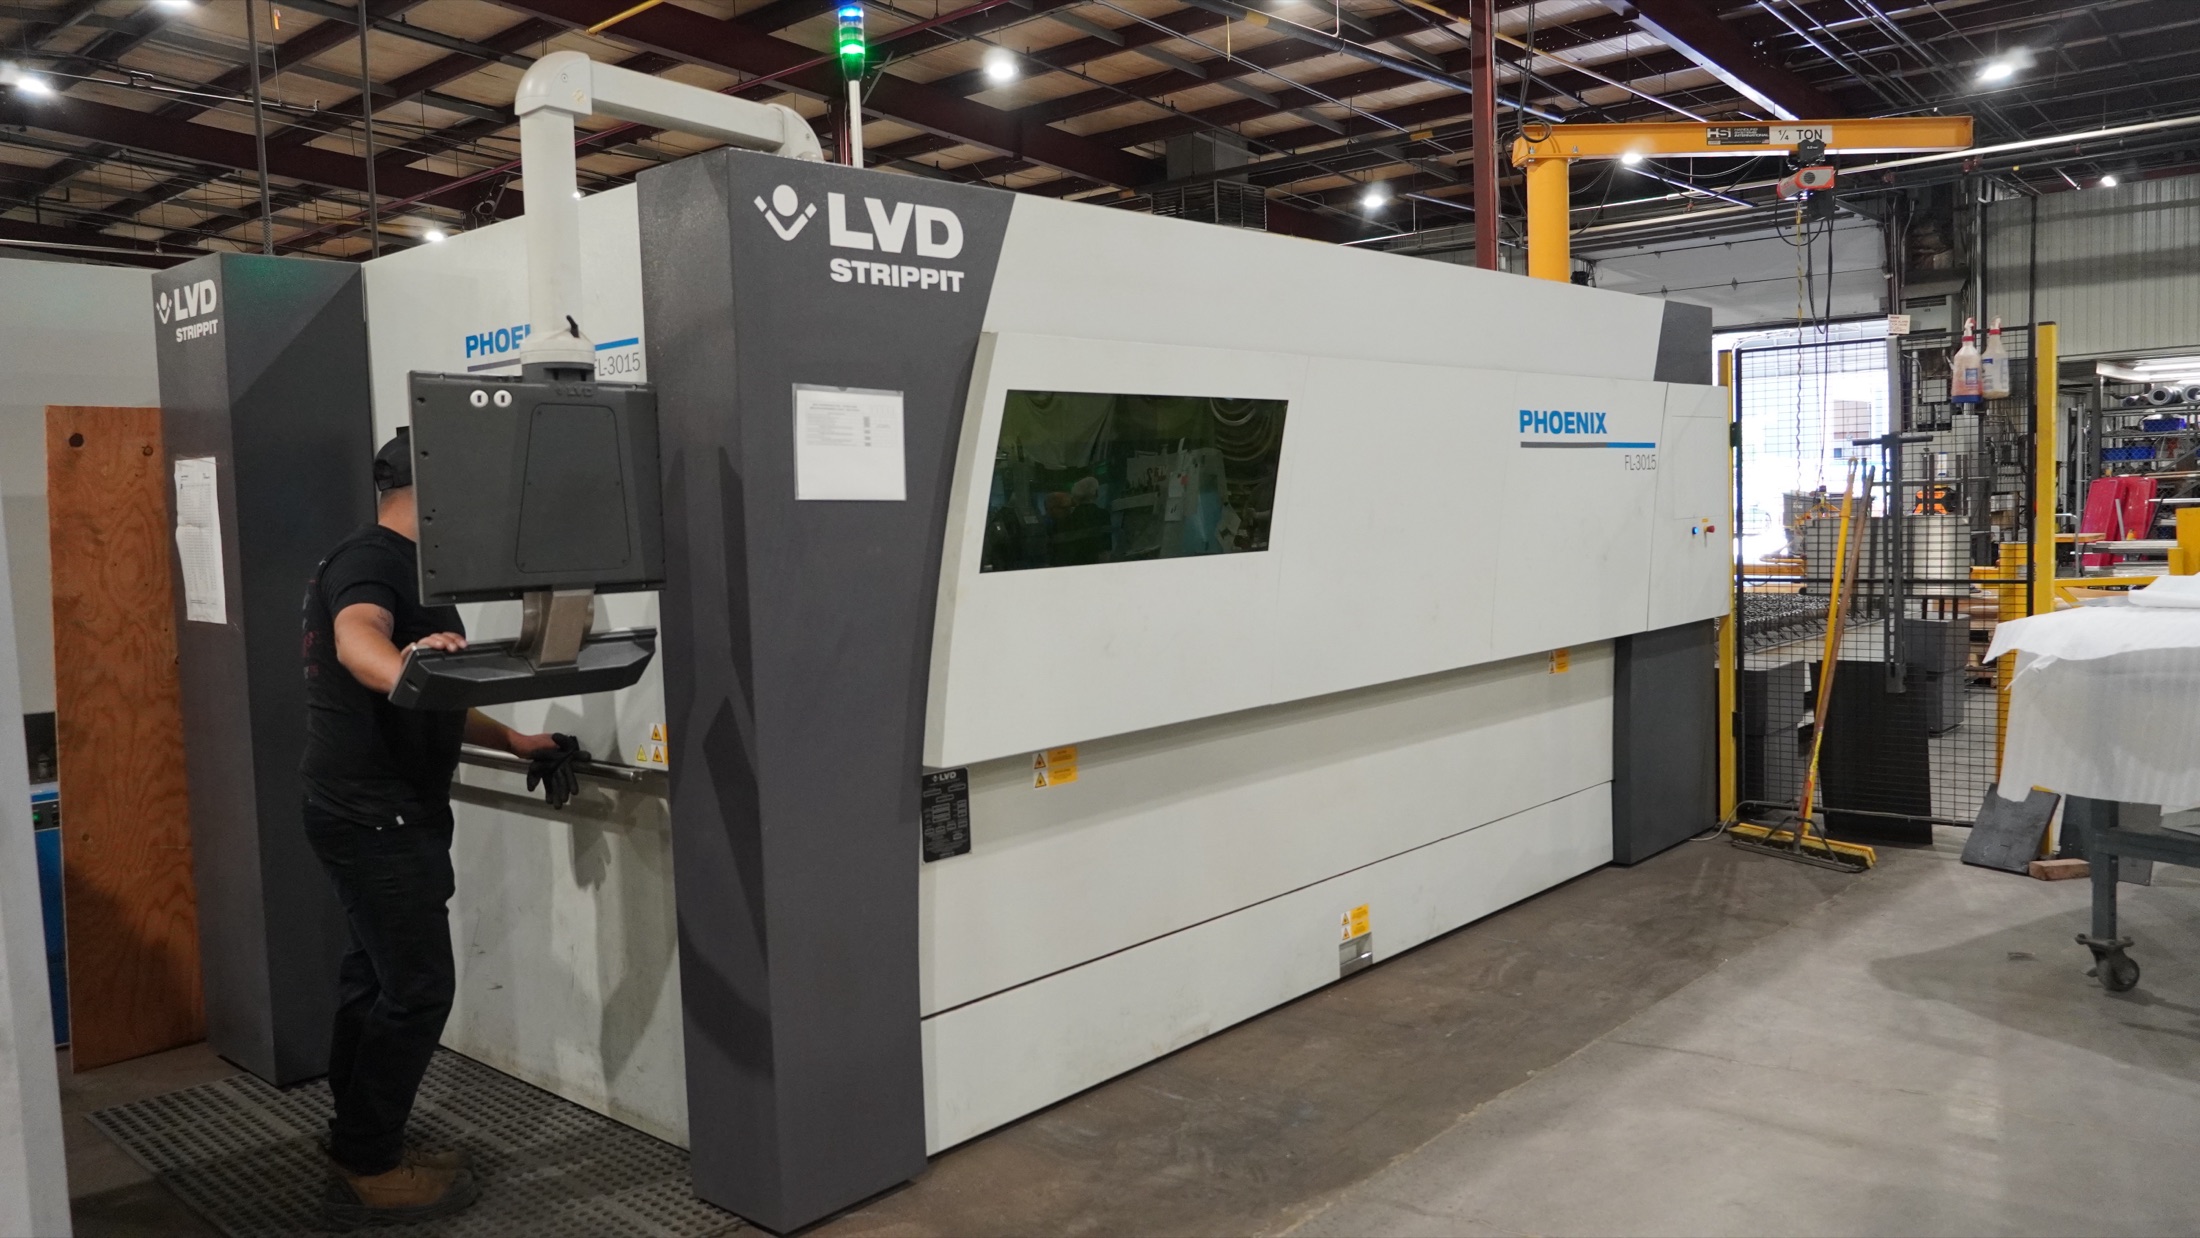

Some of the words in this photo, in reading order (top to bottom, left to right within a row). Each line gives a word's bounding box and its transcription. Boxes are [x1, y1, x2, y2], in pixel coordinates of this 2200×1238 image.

[1796, 129, 1823, 140] TON
[828, 191, 964, 260] LVD
[830, 258, 965, 293] STRIPPIT
[173, 279, 217, 321] LVD
[176, 319, 219, 343] STRIPPIT
[465, 323, 531, 358] PHOE
[1519, 409, 1608, 434] PHOENIX
[1624, 454, 1657, 471] FL-3015
[939, 771, 957, 781] LVD
